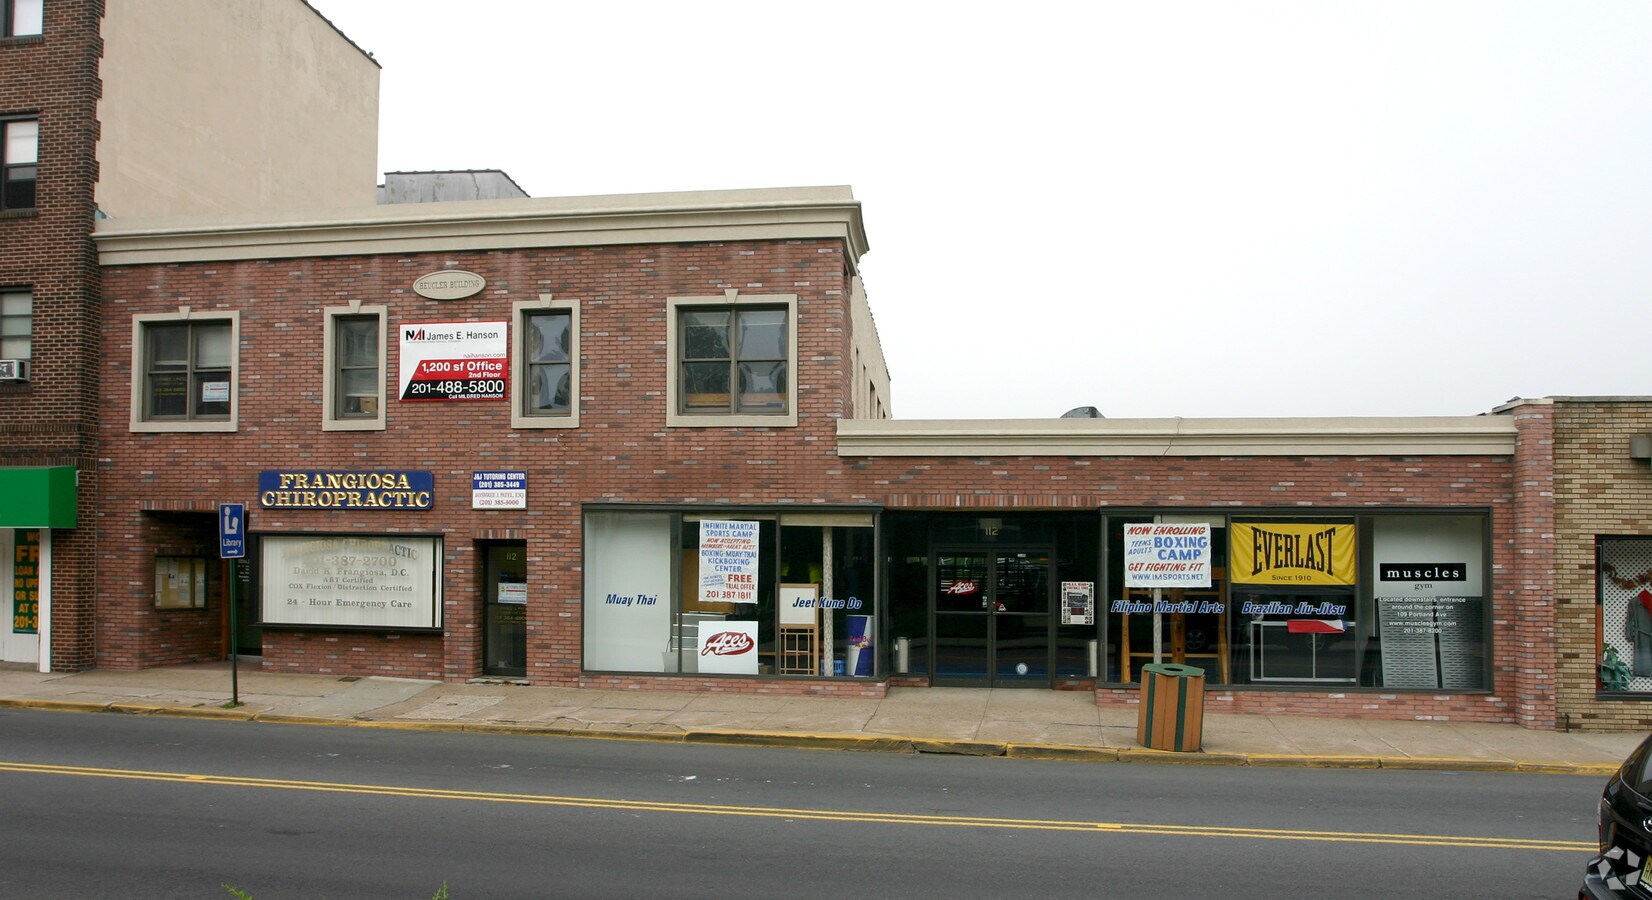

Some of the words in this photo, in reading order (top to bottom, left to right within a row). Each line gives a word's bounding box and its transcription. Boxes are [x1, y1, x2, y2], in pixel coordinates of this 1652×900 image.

[420, 281, 448, 290] BEUCLER
[450, 280, 480, 288] BUILDING
[406, 328, 425, 340] NAI
[427, 332, 454, 340] James
[456, 332, 464, 340] E.
[466, 331, 498, 339] Hanson
[422, 362, 450, 373] 1,200
[453, 362, 465, 371] sf
[467, 361, 502, 371] Office
[412, 380, 504, 394] 201-488-5800
[279, 474, 411, 489] FRANGIOSA
[261, 491, 430, 507] CHIROPRACTIC
[984, 527, 999, 536] 112
[1127, 527, 1152, 535] NOW
[1153, 527, 1206, 535] ENROLLING
[223, 539, 241, 547] Library
[1154, 536, 1207, 548] BOXING
[1128, 547, 1152, 555] ADULTS
[1157, 549, 1202, 560] CAMP
[1251, 526, 1336, 576] EVERLAST
[293, 567, 320, 575] David
[1128, 563, 1145, 571] GET
[1145, 563, 1186, 571] FIGHTING
[1188, 563, 1204, 571] FIT
[1387, 567, 1460, 578] muscles
[728, 574, 752, 582] FREE
[948, 581, 975, 594] Aces
[15, 591, 26, 600] OR
[606, 594, 633, 607] Muay
[636, 594, 658, 605] Thai
[18, 604, 29, 613] AT
[336, 599, 387, 608] Emergency
[792, 597, 816, 608] Jeet
[819, 597, 845, 609] Kune
[847, 597, 862, 609] Do
[1111, 600, 1152, 615] Filipino
[1154, 600, 1198, 613] Martial
[1198, 601, 1225, 613] Arts
[1242, 601, 1292, 614] Brazilian
[1294, 602, 1346, 615] Jiu-Jitsu
[14, 616, 38, 628] 201-3
[701, 632, 750, 656] Aces
